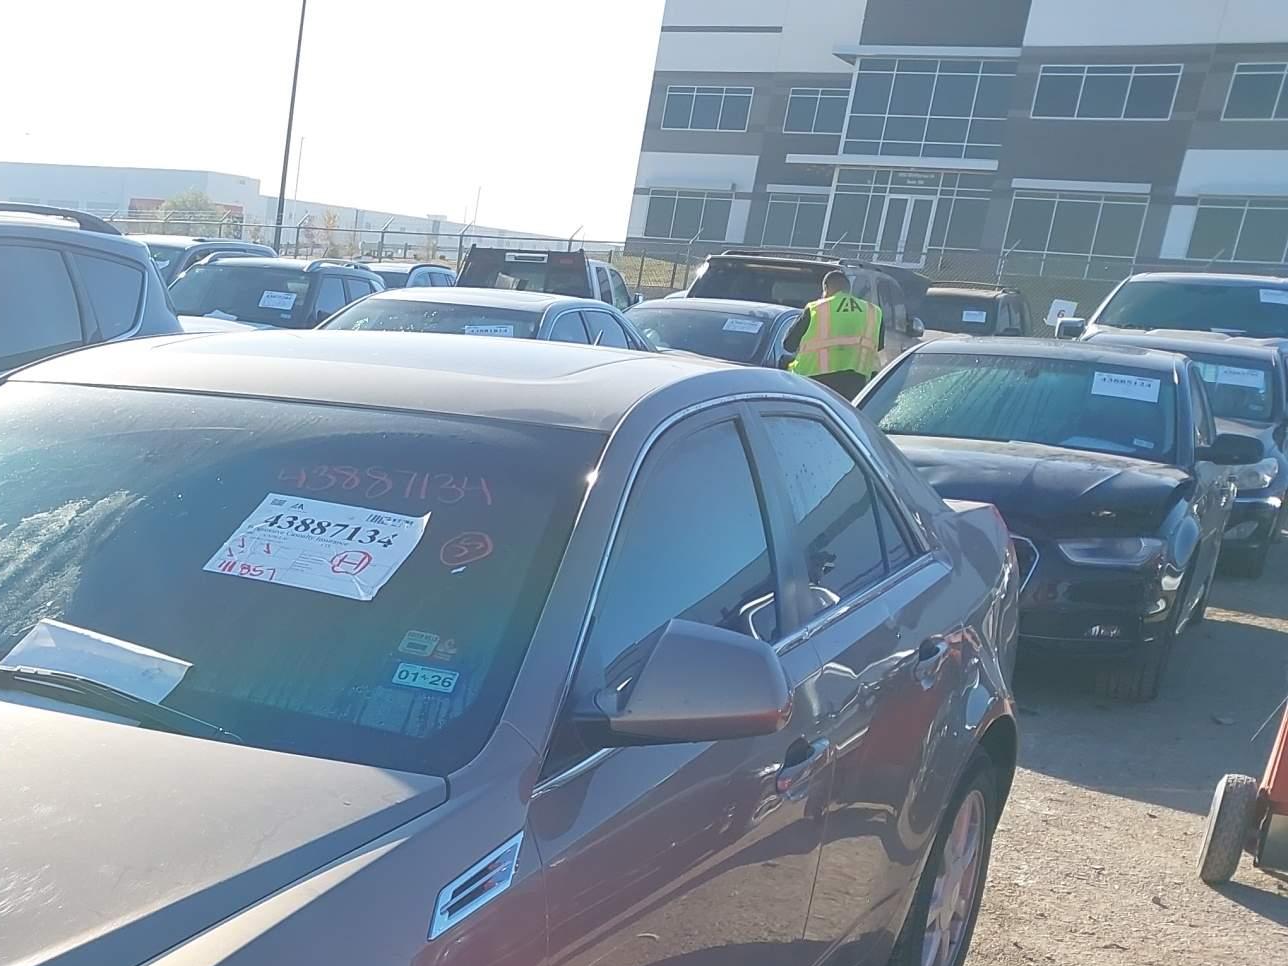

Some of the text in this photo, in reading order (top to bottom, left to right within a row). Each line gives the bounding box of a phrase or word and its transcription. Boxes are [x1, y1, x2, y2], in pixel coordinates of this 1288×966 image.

[1056, 309, 1066, 318] 6
[278, 465, 493, 505] 43887134
[264, 513, 398, 549] 43887134
